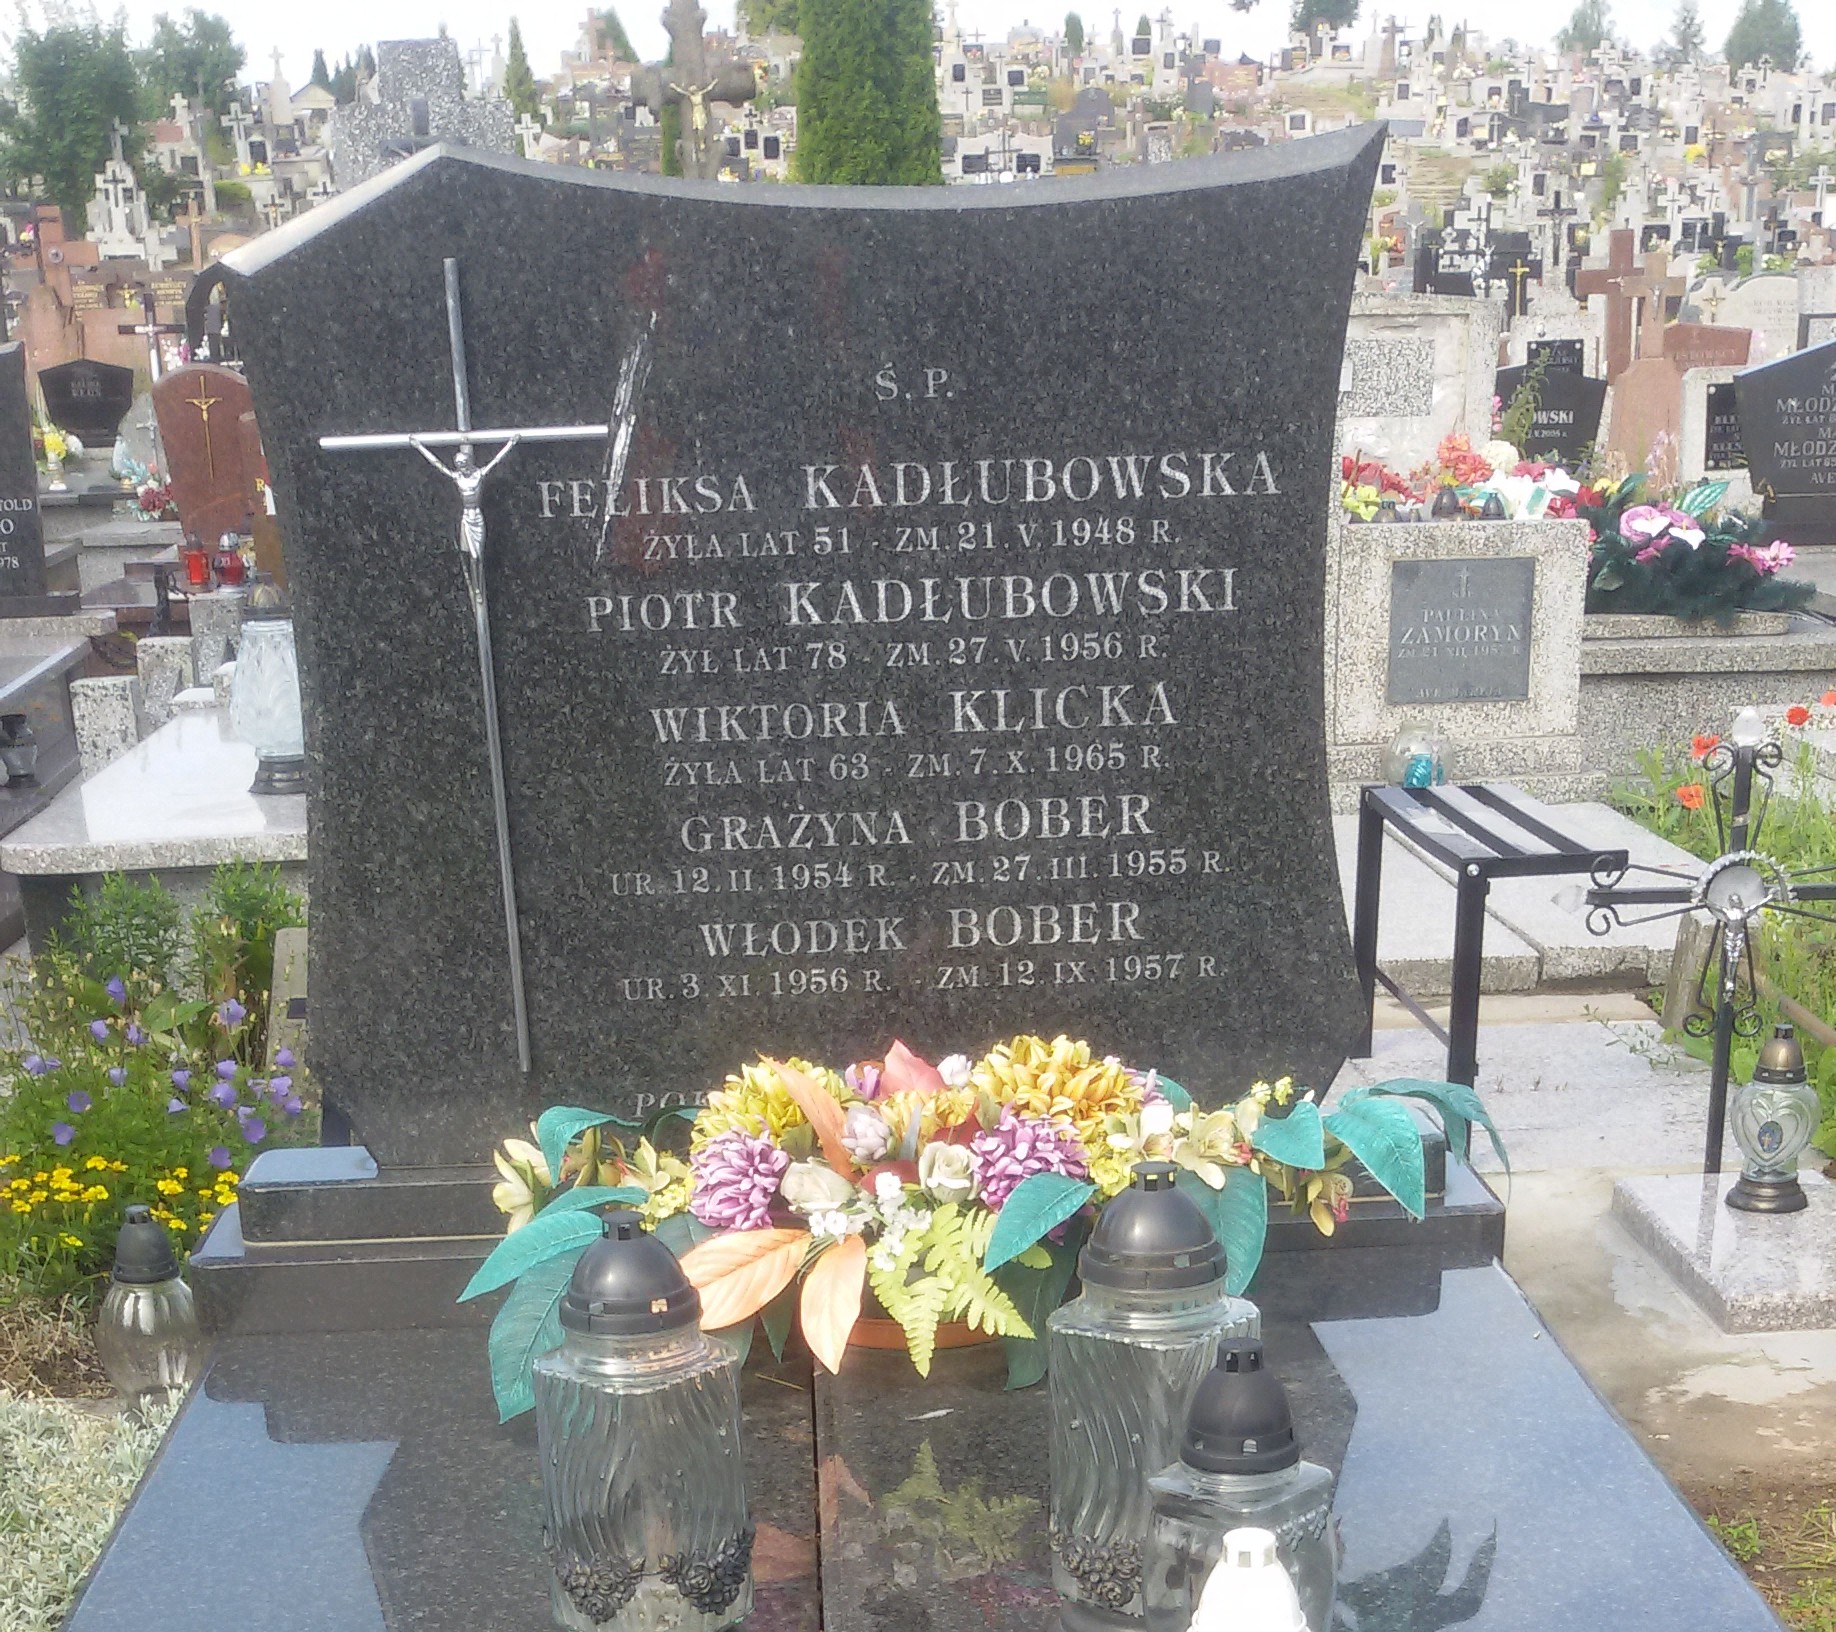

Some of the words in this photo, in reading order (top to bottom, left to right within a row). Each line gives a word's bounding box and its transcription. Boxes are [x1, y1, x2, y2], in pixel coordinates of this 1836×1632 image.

[923, 367, 955, 398] P.
[537, 474, 758, 519] FELIKSA
[802, 450, 1282, 510] KADŁUBOWSKA
[643, 529, 725, 561] ŻYŁA
[739, 530, 800, 559] LAT
[813, 526, 851, 555] 51
[895, 526, 950, 552] ZM.
[1051, 516, 1136, 547] 1948
[1151, 518, 1182, 545] R.
[584, 591, 744, 634] PIOTR
[784, 566, 1240, 627] KADŁUBOWSKI
[660, 643, 720, 674] ŻYŁ
[734, 645, 793, 672] LAT
[806, 641, 847, 669] 78
[1040, 632, 1124, 662] 1956
[1138, 634, 1168, 659] R.
[649, 700, 907, 745] WIKTORIA
[948, 680, 1180, 734] KLICKA
[664, 756, 743, 787] ŻYŁA
[757, 757, 816, 784] LAT
[829, 752, 870, 781] 63
[908, 753, 962, 779] ZM.
[1046, 742, 1127, 772] 1965
[1141, 745, 1171, 769] R.
[680, 803, 914, 853] GRAŻYNA
[954, 794, 1157, 843] BOBER
[773, 861, 854, 892] 1954
[867, 863, 896, 888] R.
[931, 861, 985, 888] ZM.
[1107, 848, 1188, 878] 1955
[699, 916, 908, 959] WŁODEK
[947, 901, 1146, 951] BOBER
[769, 967, 849, 997] 1956
[863, 969, 893, 993] R.
[1107, 953, 1186, 983] 1957
[1199, 955, 1226, 979] R.
